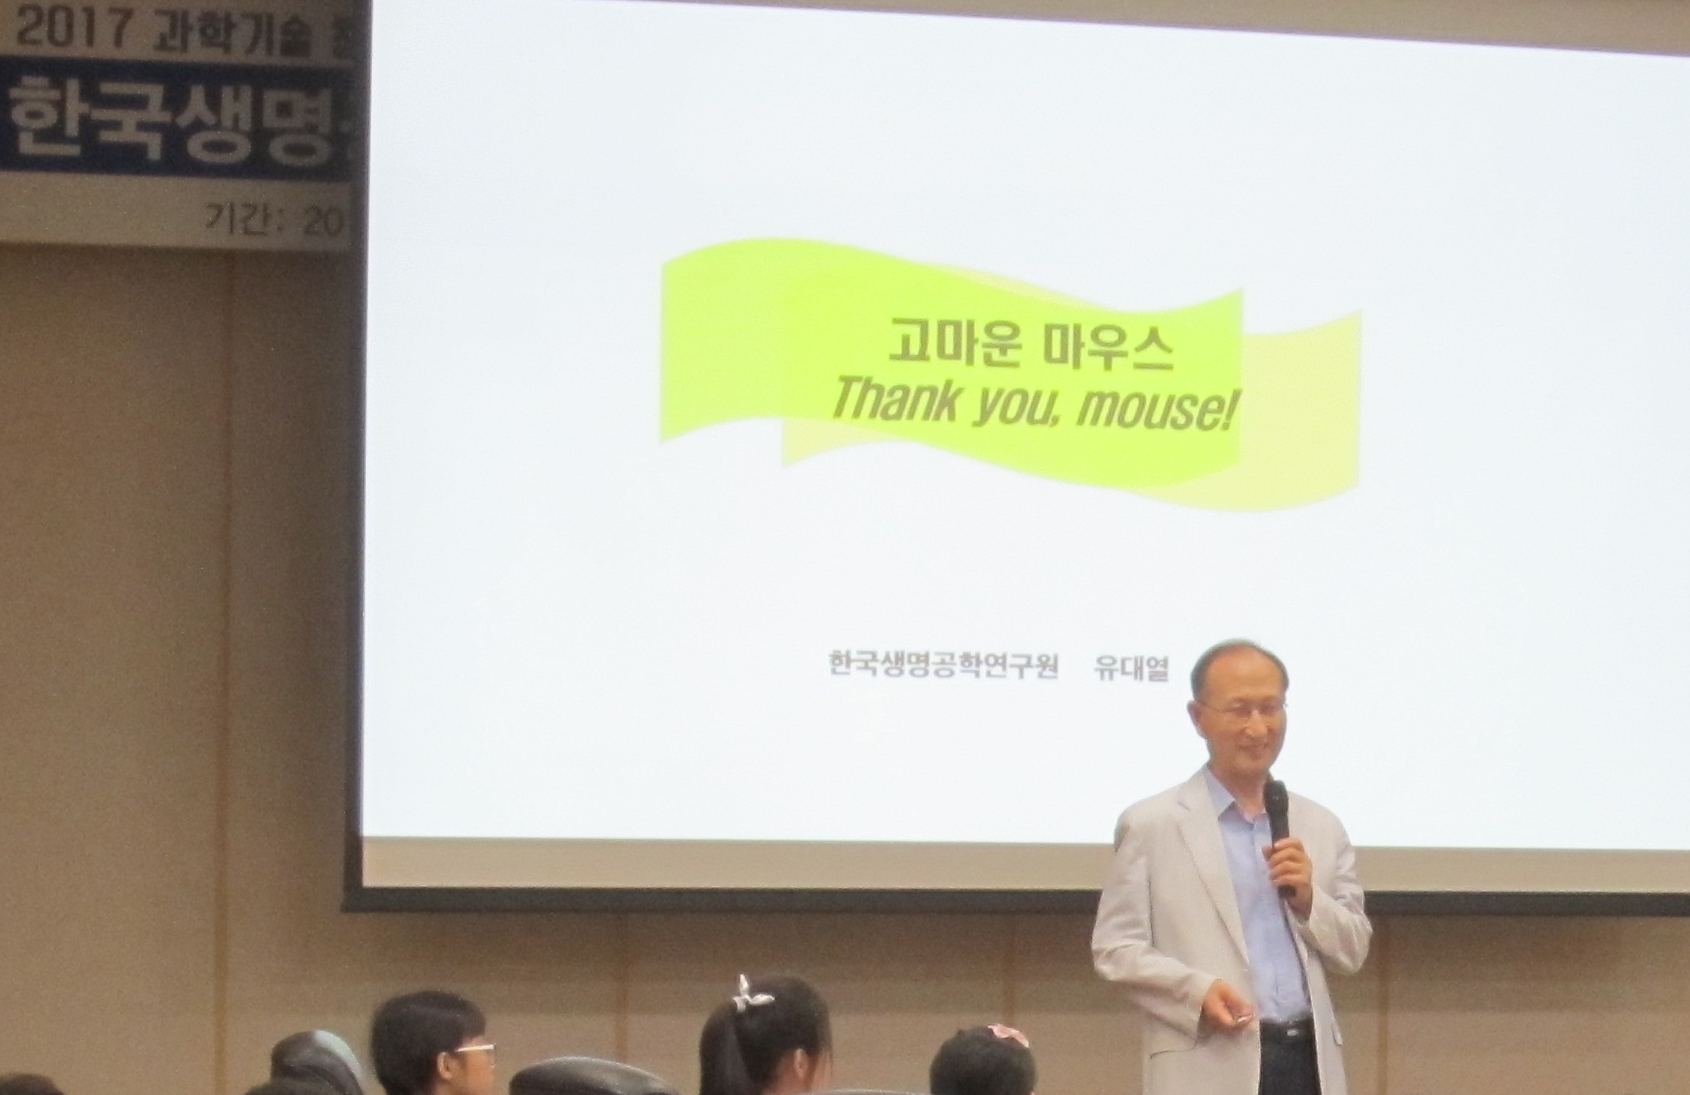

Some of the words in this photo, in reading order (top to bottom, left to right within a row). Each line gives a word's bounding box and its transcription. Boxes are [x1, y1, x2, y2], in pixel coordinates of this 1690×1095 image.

[15, 4, 134, 49] 2017
[153, 9, 313, 58] 과학기술
[8, 74, 352, 169] 한국생명
[888, 317, 1023, 368] 고마운
[1043, 322, 1175, 372] 마우스
[832, 374, 965, 423] Thank
[971, 385, 1060, 428] you,
[1075, 387, 1244, 432] mouse!
[828, 648, 1060, 680] 한국생명공학연구원
[1094, 654, 1170, 683] 유대열
